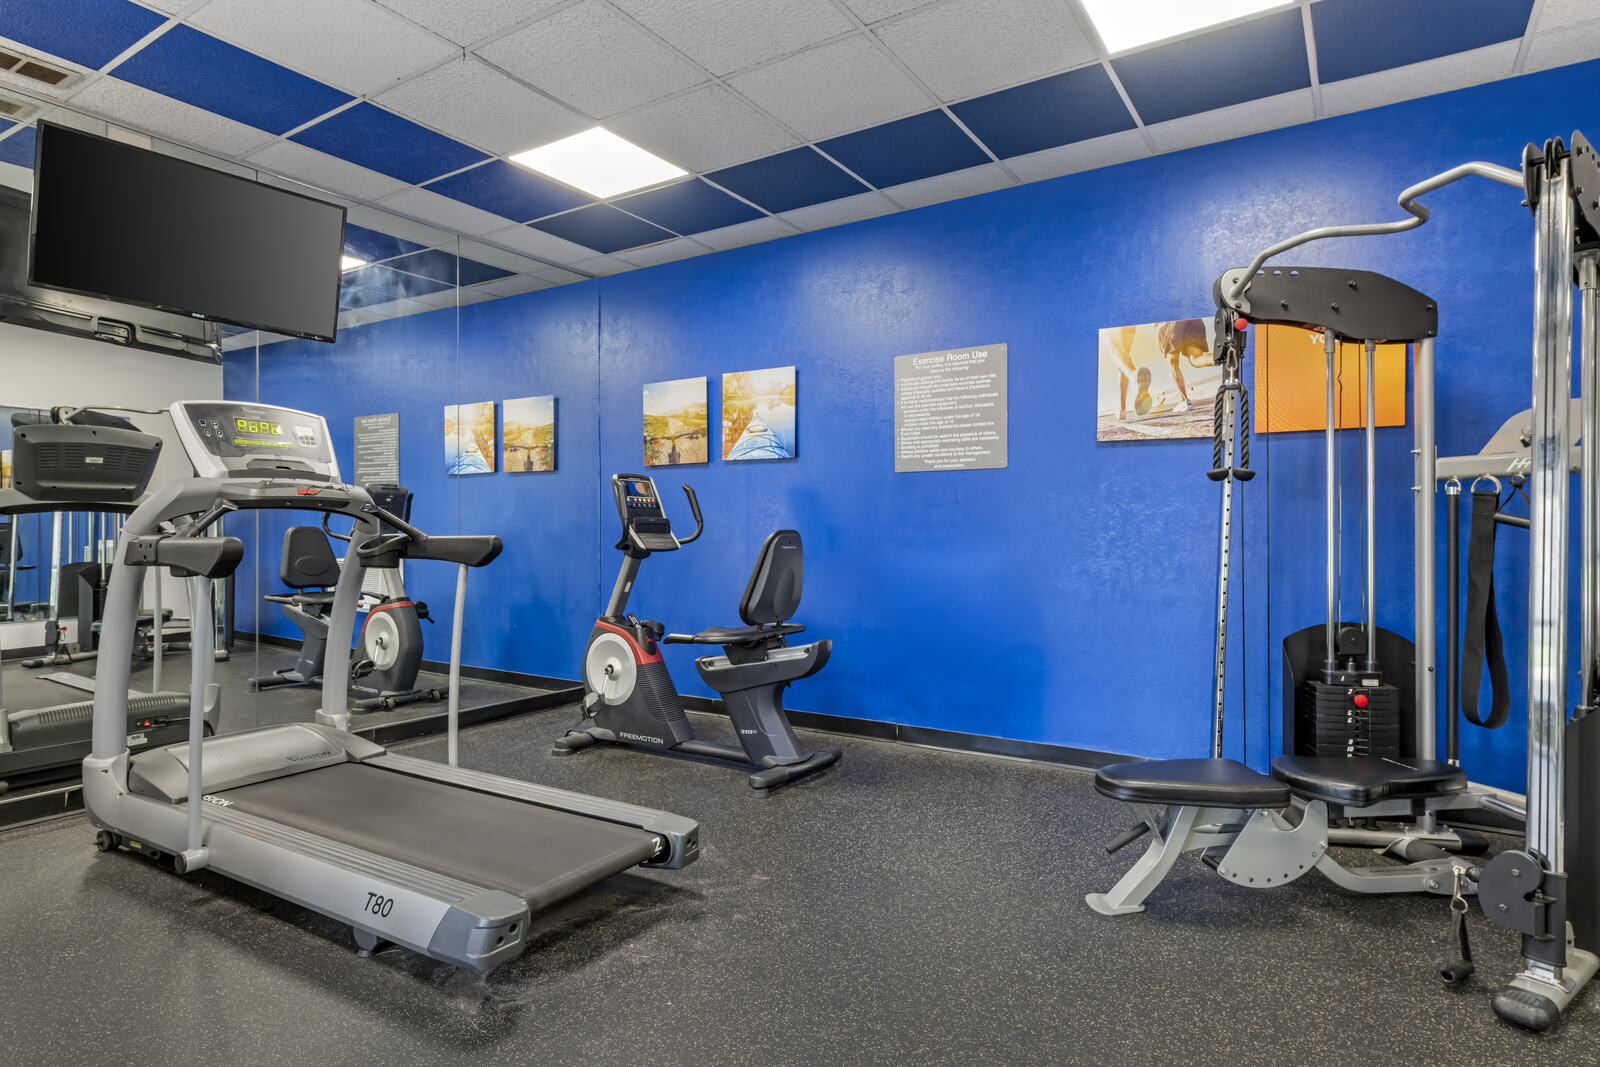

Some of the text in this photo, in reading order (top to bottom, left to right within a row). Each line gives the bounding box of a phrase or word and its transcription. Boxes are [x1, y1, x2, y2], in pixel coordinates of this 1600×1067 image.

[912, 350, 988, 366] Exercise Room Use
[619, 731, 664, 745] FREEMOTION
[364, 891, 394, 918] T80
